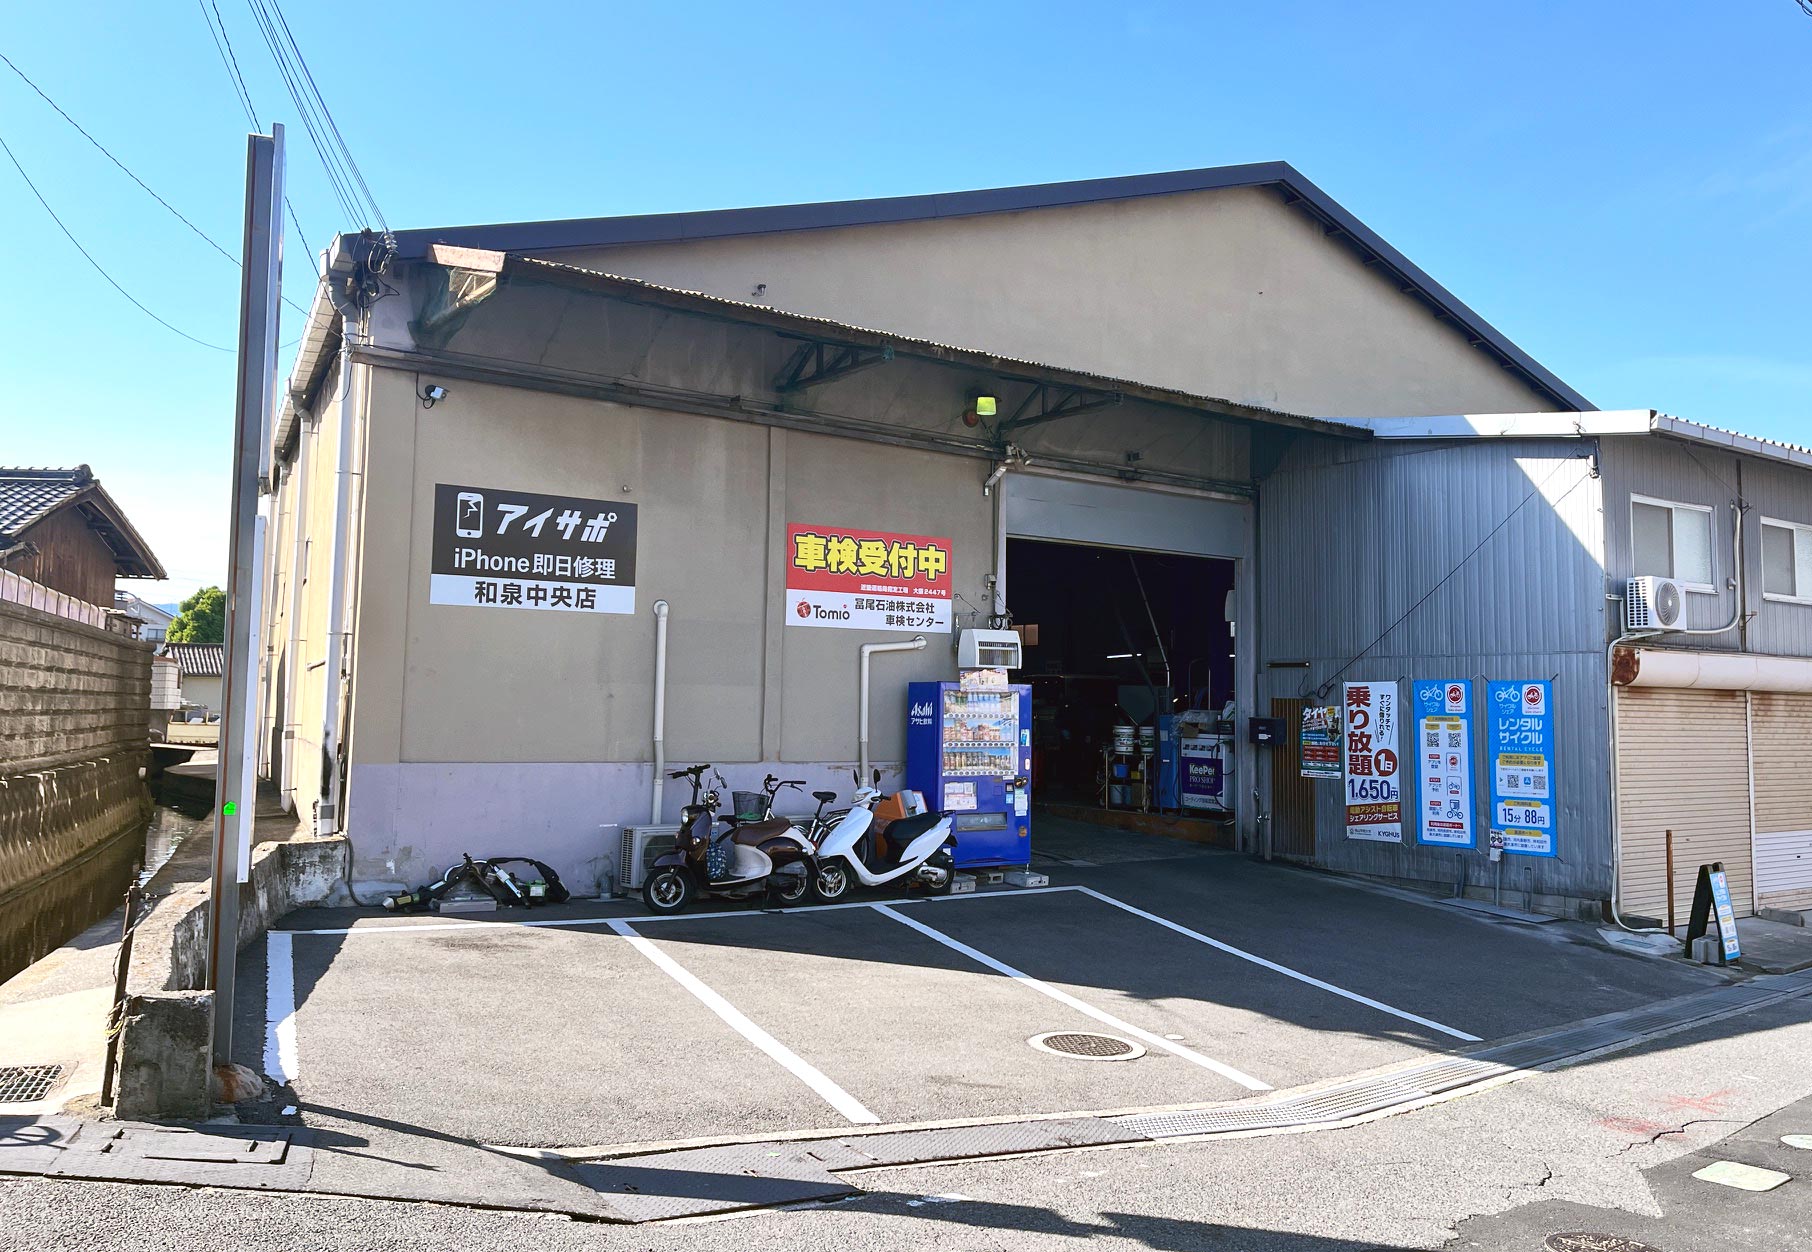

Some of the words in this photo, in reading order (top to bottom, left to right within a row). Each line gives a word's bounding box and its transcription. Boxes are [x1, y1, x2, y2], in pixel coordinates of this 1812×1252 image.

[496, 503, 618, 543] アイサポ
[454, 547, 616, 579] iPhone即日修理
[793, 532, 947, 581] 車検受付中
[474, 580, 597, 610] 和泉中央店
[813, 604, 850, 620] Tomio
[885, 614, 944, 628] 車検センター
[911, 701, 932, 717] Asahi
[1346, 685, 1373, 777] 乗り放題
[1498, 717, 1543, 731] レンタル
[1498, 731, 1543, 745] サイクル
[1189, 764, 1215, 776] KeePer
[1378, 753, 1393, 772] 1日
[1348, 778, 1399, 800] 1,650円
[1502, 808, 1521, 824] 15分
[1524, 809, 1545, 825] 88円
